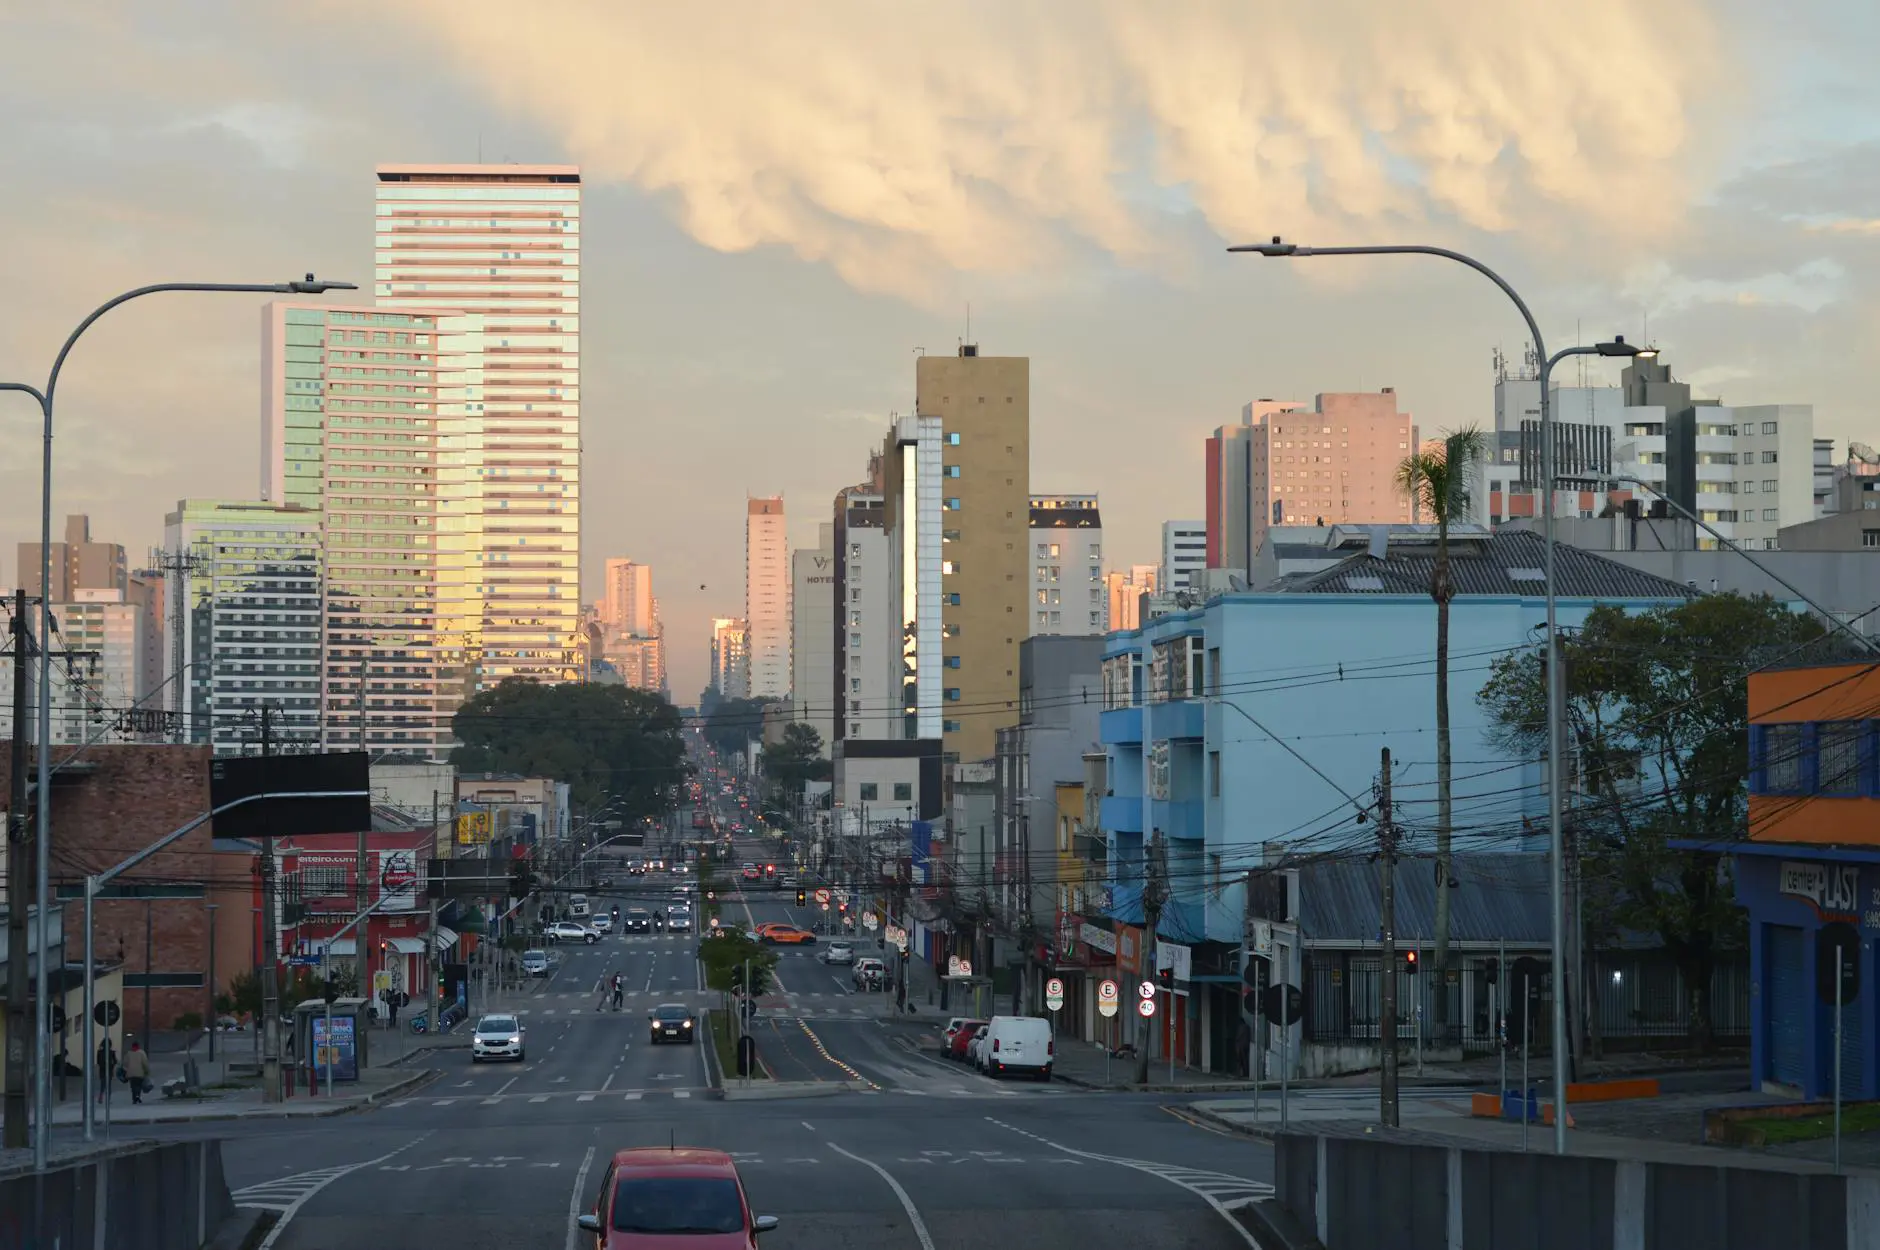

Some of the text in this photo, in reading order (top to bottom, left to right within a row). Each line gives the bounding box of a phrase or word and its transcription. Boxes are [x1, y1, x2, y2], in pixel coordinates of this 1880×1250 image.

[1052, 982, 1058, 992] E
[1105, 984, 1112, 995] E
[1141, 1003, 1152, 1011] 40
